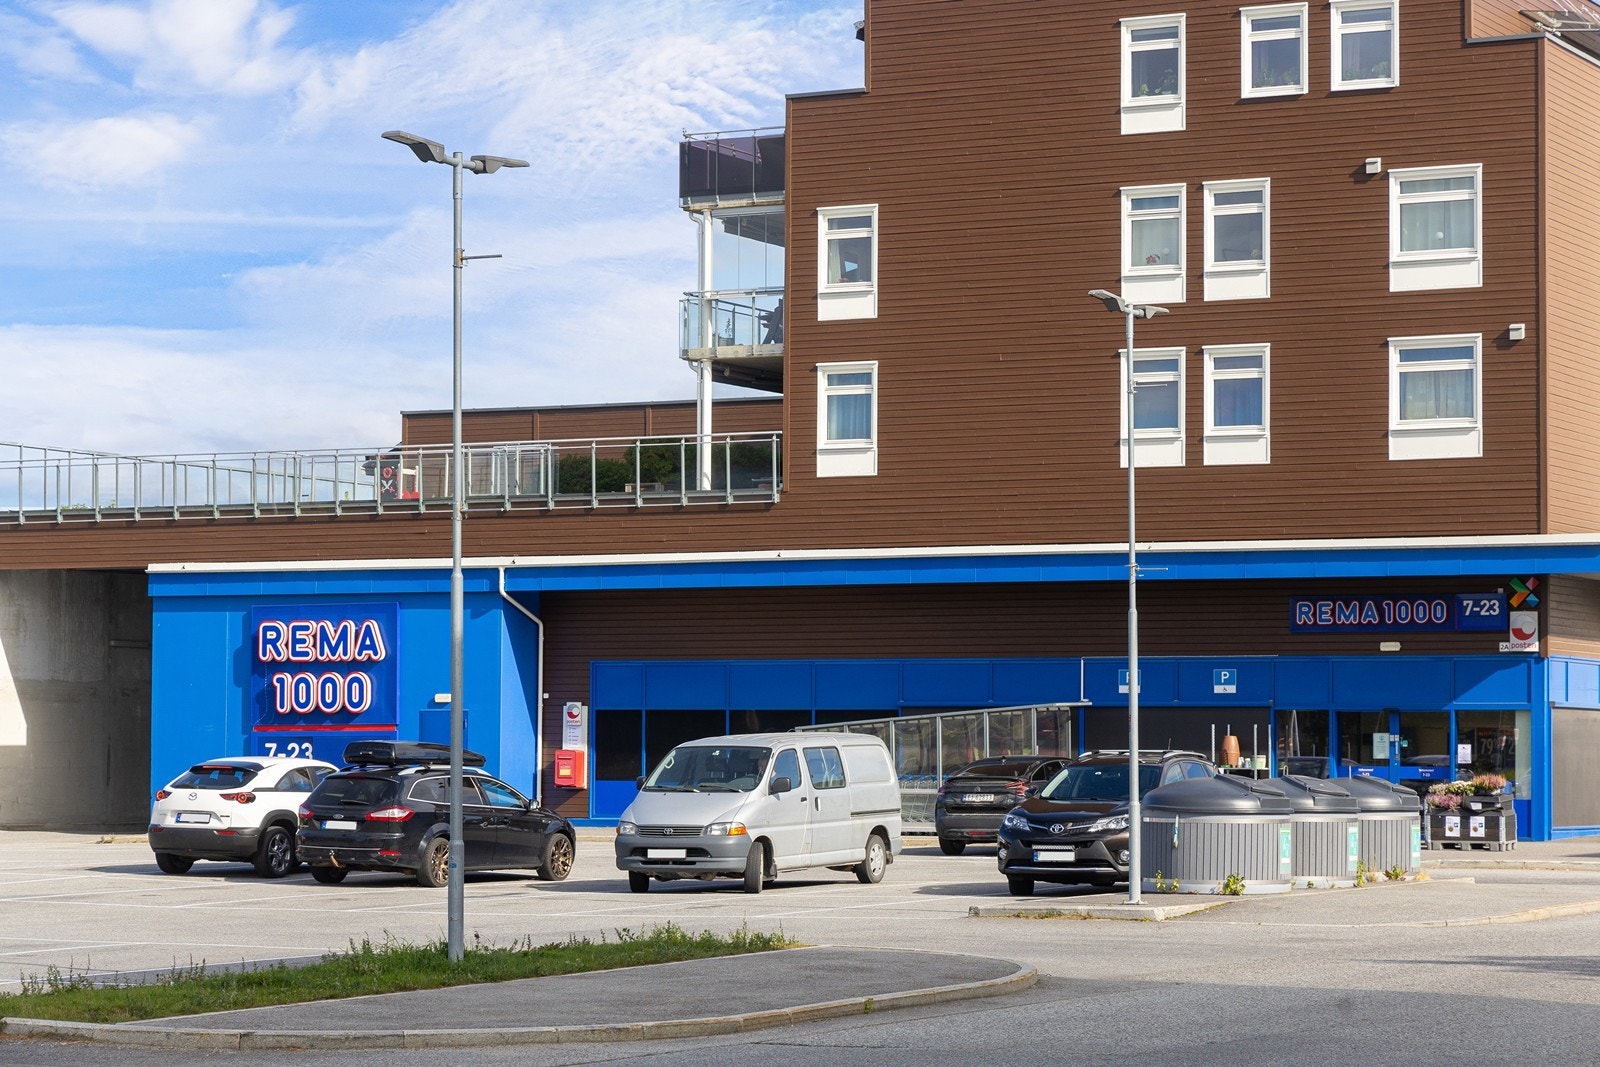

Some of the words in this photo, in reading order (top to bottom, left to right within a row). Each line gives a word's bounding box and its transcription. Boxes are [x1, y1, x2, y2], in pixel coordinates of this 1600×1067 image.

[1296, 600, 1379, 625] REMA
[1383, 600, 1447, 624] 1000
[1463, 600, 1500, 616] 7-23
[258, 619, 387, 662] REMA
[1221, 671, 1230, 684] P
[272, 671, 372, 714] 1000
[264, 742, 313, 759] 7-23
